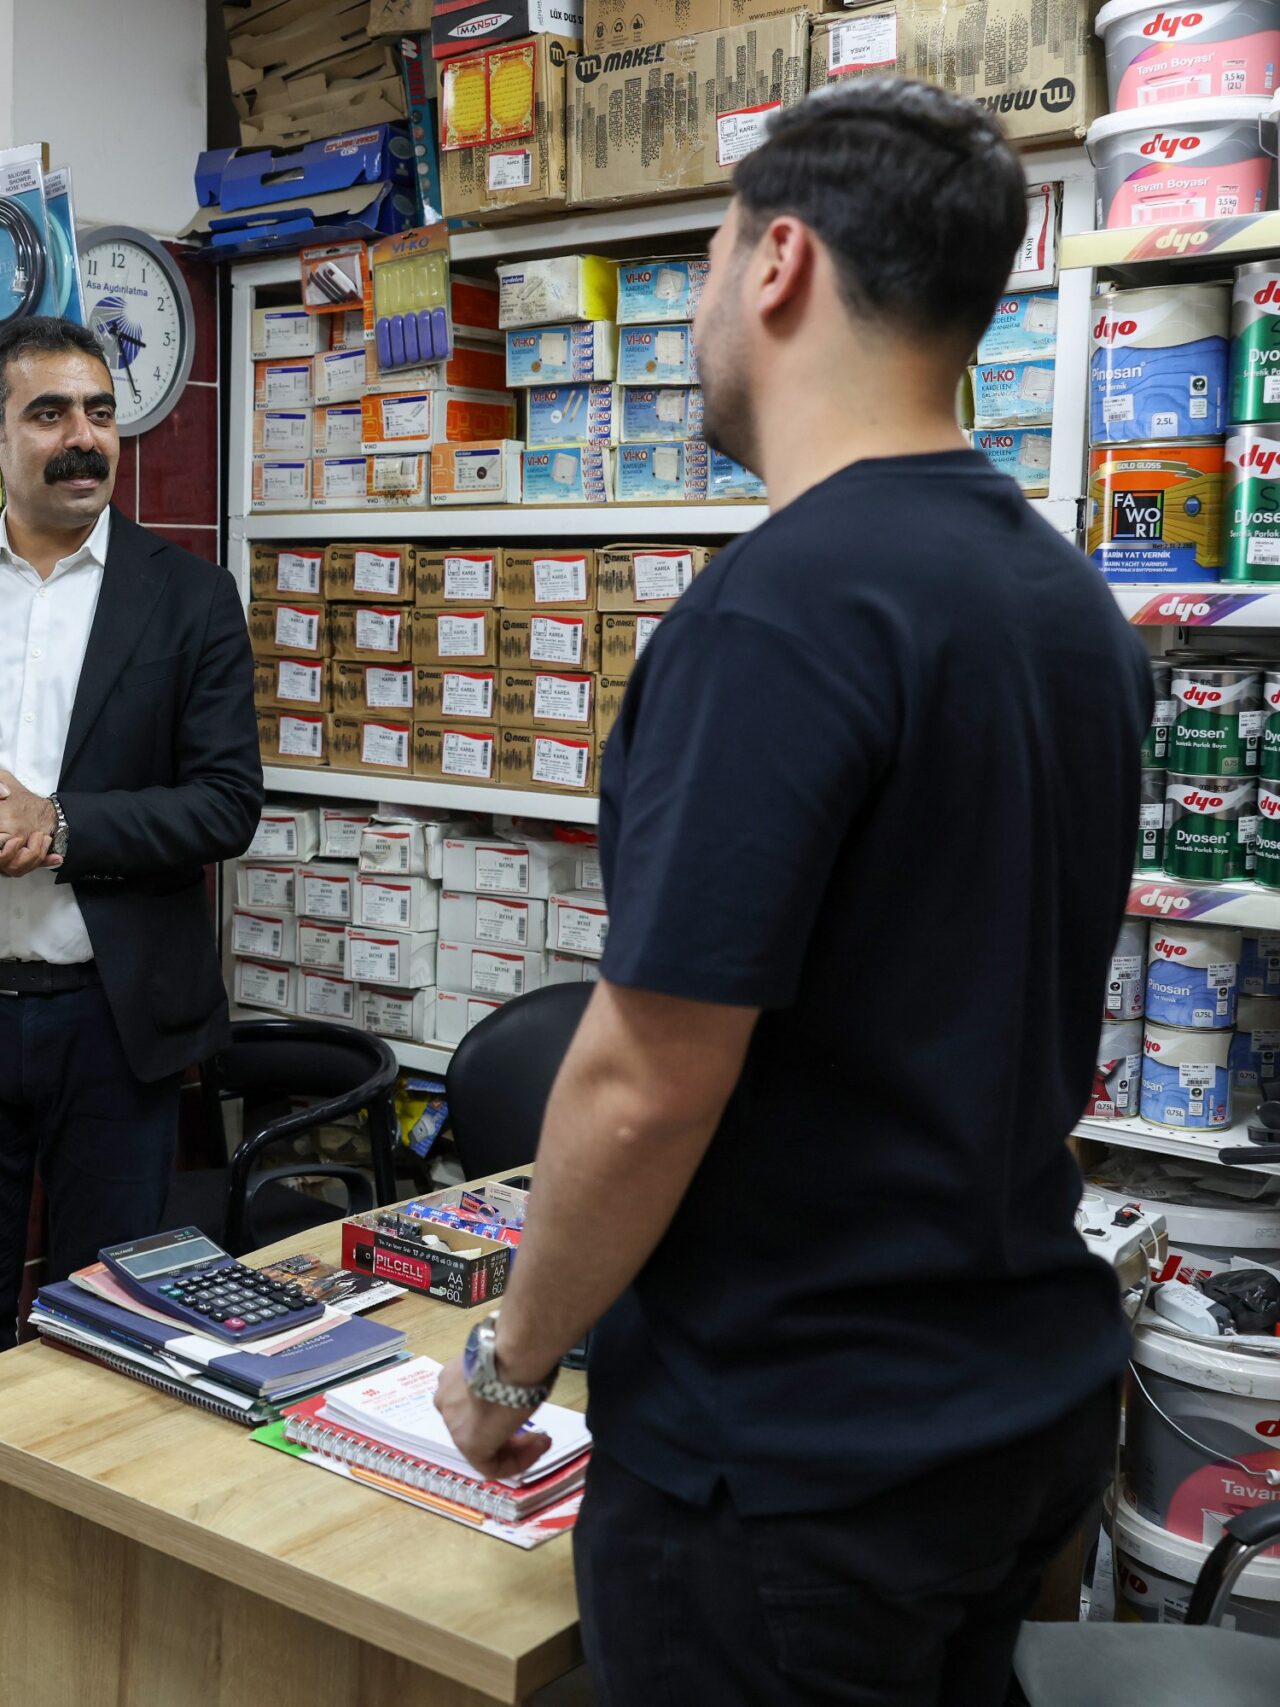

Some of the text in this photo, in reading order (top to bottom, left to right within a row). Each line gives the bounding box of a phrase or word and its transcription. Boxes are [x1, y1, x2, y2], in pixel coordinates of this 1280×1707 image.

[1143, 12, 1203, 37] dyo
[603, 43, 666, 73] MAKEL
[1136, 61, 1168, 76] Tavan
[1140, 133, 1201, 158] dyo
[7, 169, 31, 180] SILICONE
[9, 175, 32, 186] SHOWER
[5, 183, 20, 193] HOSE
[1132, 181, 1164, 193] Tavan
[1156, 228, 1209, 253] dyo
[87, 259, 98, 276] 11
[111, 252, 126, 269] 12
[141, 268, 146, 284] 1
[86, 279, 149, 297] Asa Aydınlatma
[157, 297, 165, 312] 2
[1093, 315, 1137, 345] dyo
[163, 332, 171, 347] 3
[153, 366, 161, 381] 4
[1137, 462, 1162, 470] GLOSS
[1114, 493, 1136, 508] FA
[1125, 508, 1161, 523] WO
[1234, 509, 1280, 527] Dyose
[1135, 525, 1155, 538] RI
[1124, 551, 1140, 559] YAT
[1159, 597, 1210, 622] dyo
[1184, 687, 1221, 706] dyo
[1177, 725, 1225, 740] Dyosen
[1184, 792, 1224, 811] dyo
[1177, 830, 1227, 844] Dyosen
[1140, 888, 1190, 914] dyo
[1154, 938, 1187, 958] dyo
[1143, 1079, 1163, 1093] osan
[447, 1271, 464, 1287] AA
[493, 1264, 505, 1279] AA
[446, 1289, 461, 1303] 60
[491, 1281, 502, 1296] 60
